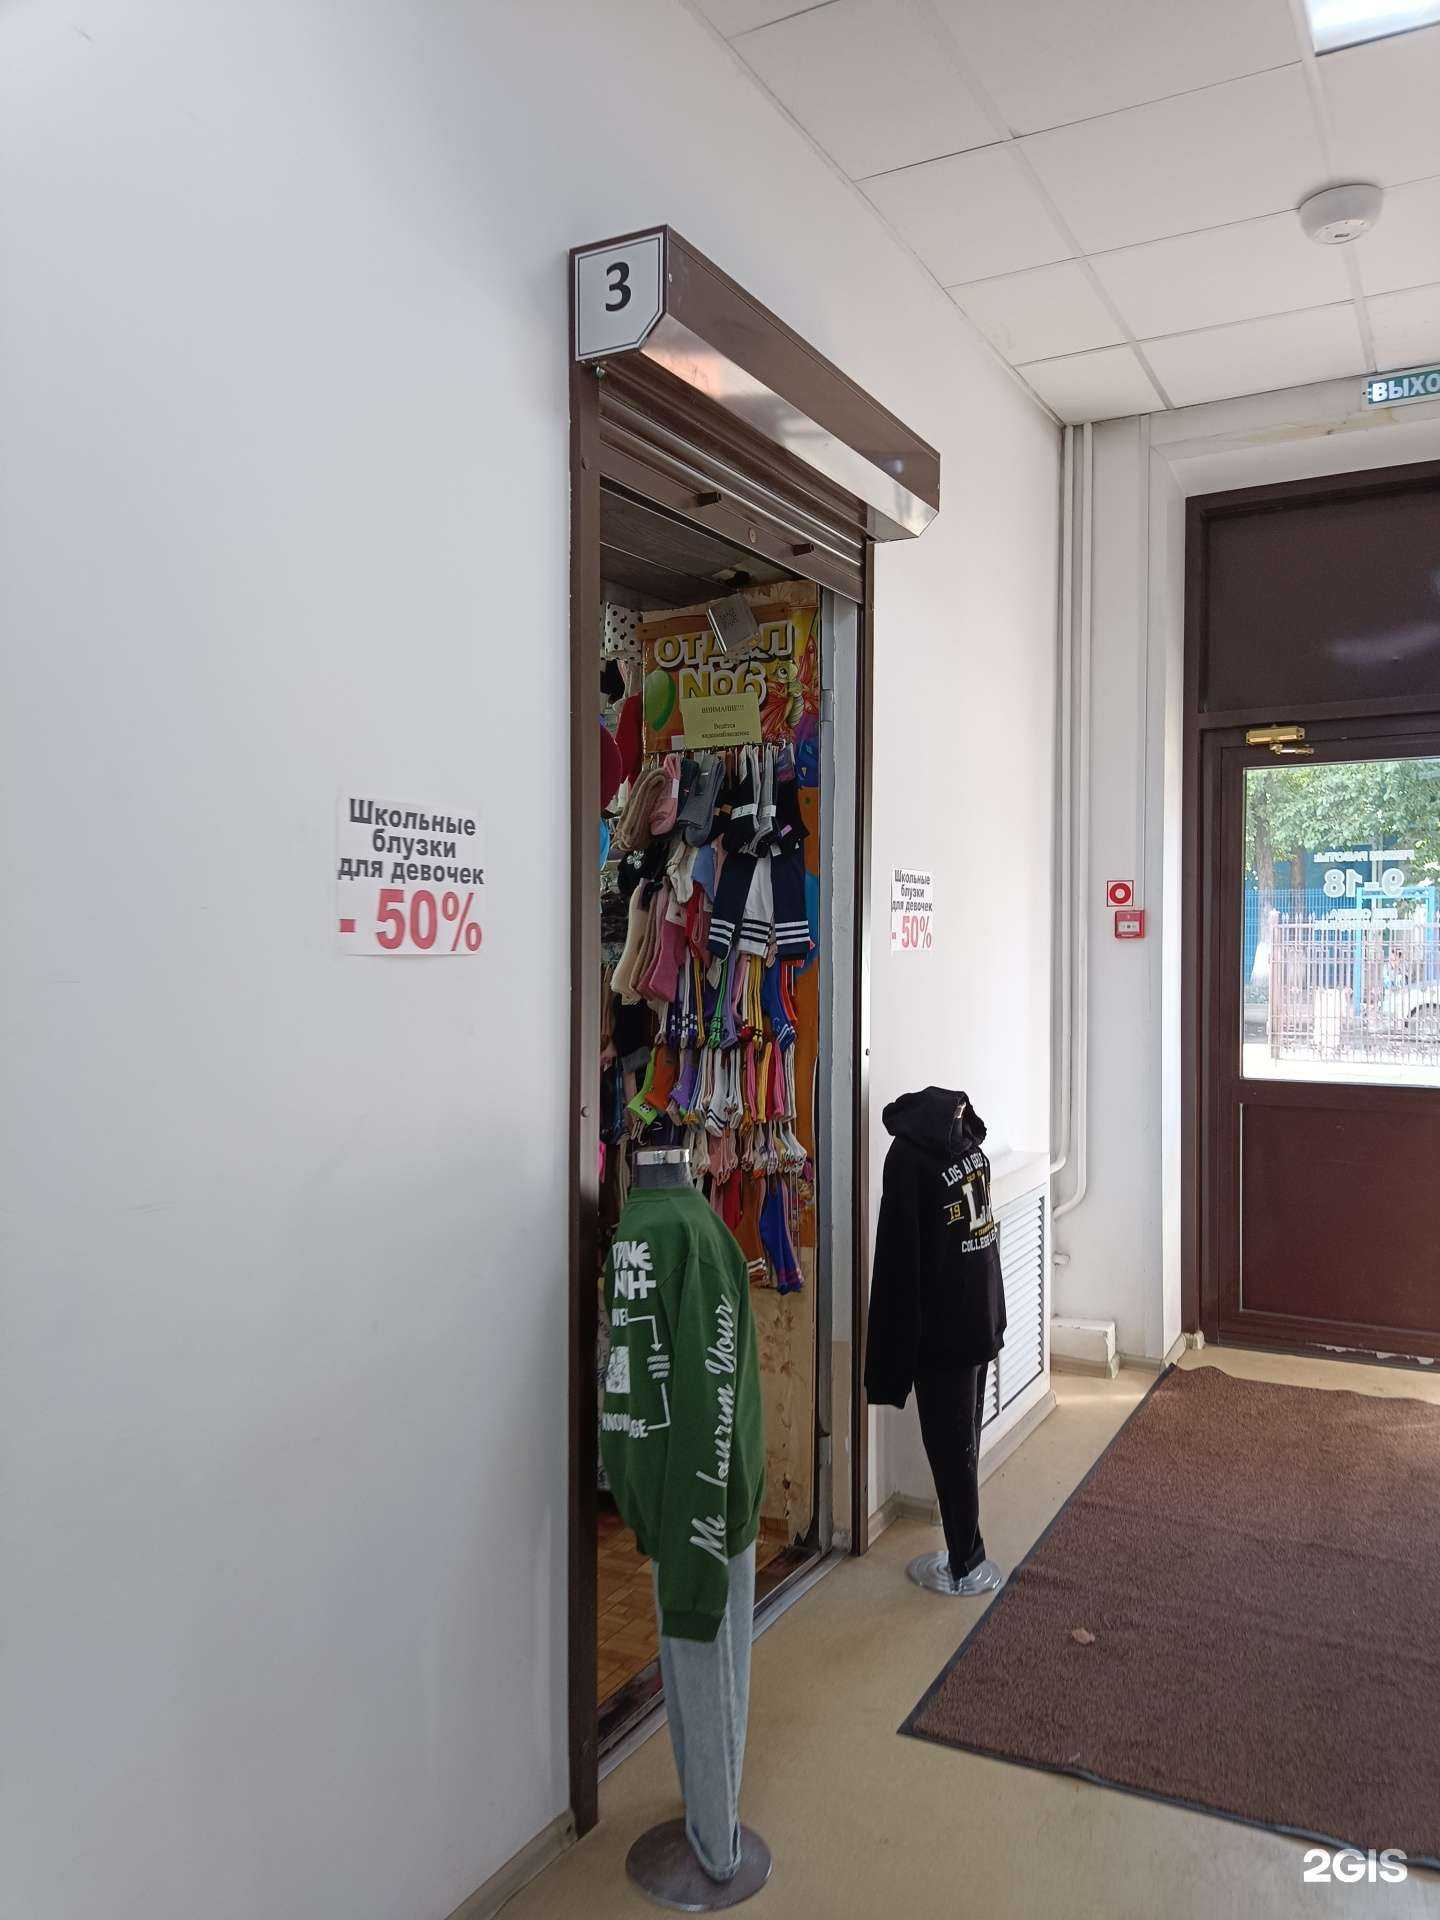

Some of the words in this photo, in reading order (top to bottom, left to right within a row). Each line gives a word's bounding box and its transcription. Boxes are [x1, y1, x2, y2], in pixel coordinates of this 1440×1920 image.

[605, 262, 631, 312] 3
[1372, 373, 1440, 402] ВЫХО
[654, 620, 794, 671] ОТДЛ
[350, 798, 476, 836] Школьные
[372, 828, 457, 860] блузки
[337, 857, 383, 881] для
[391, 861, 484, 884] девочек
[894, 869, 931, 885] Школьные
[891, 900, 904, 912] для
[905, 901, 932, 912] девочек
[901, 884, 924, 900] блузки
[375, 888, 482, 951] 50%
[901, 915, 932, 948] 50%
[942, 1164, 963, 1187] LOS
[949, 1204, 961, 1220] 19
